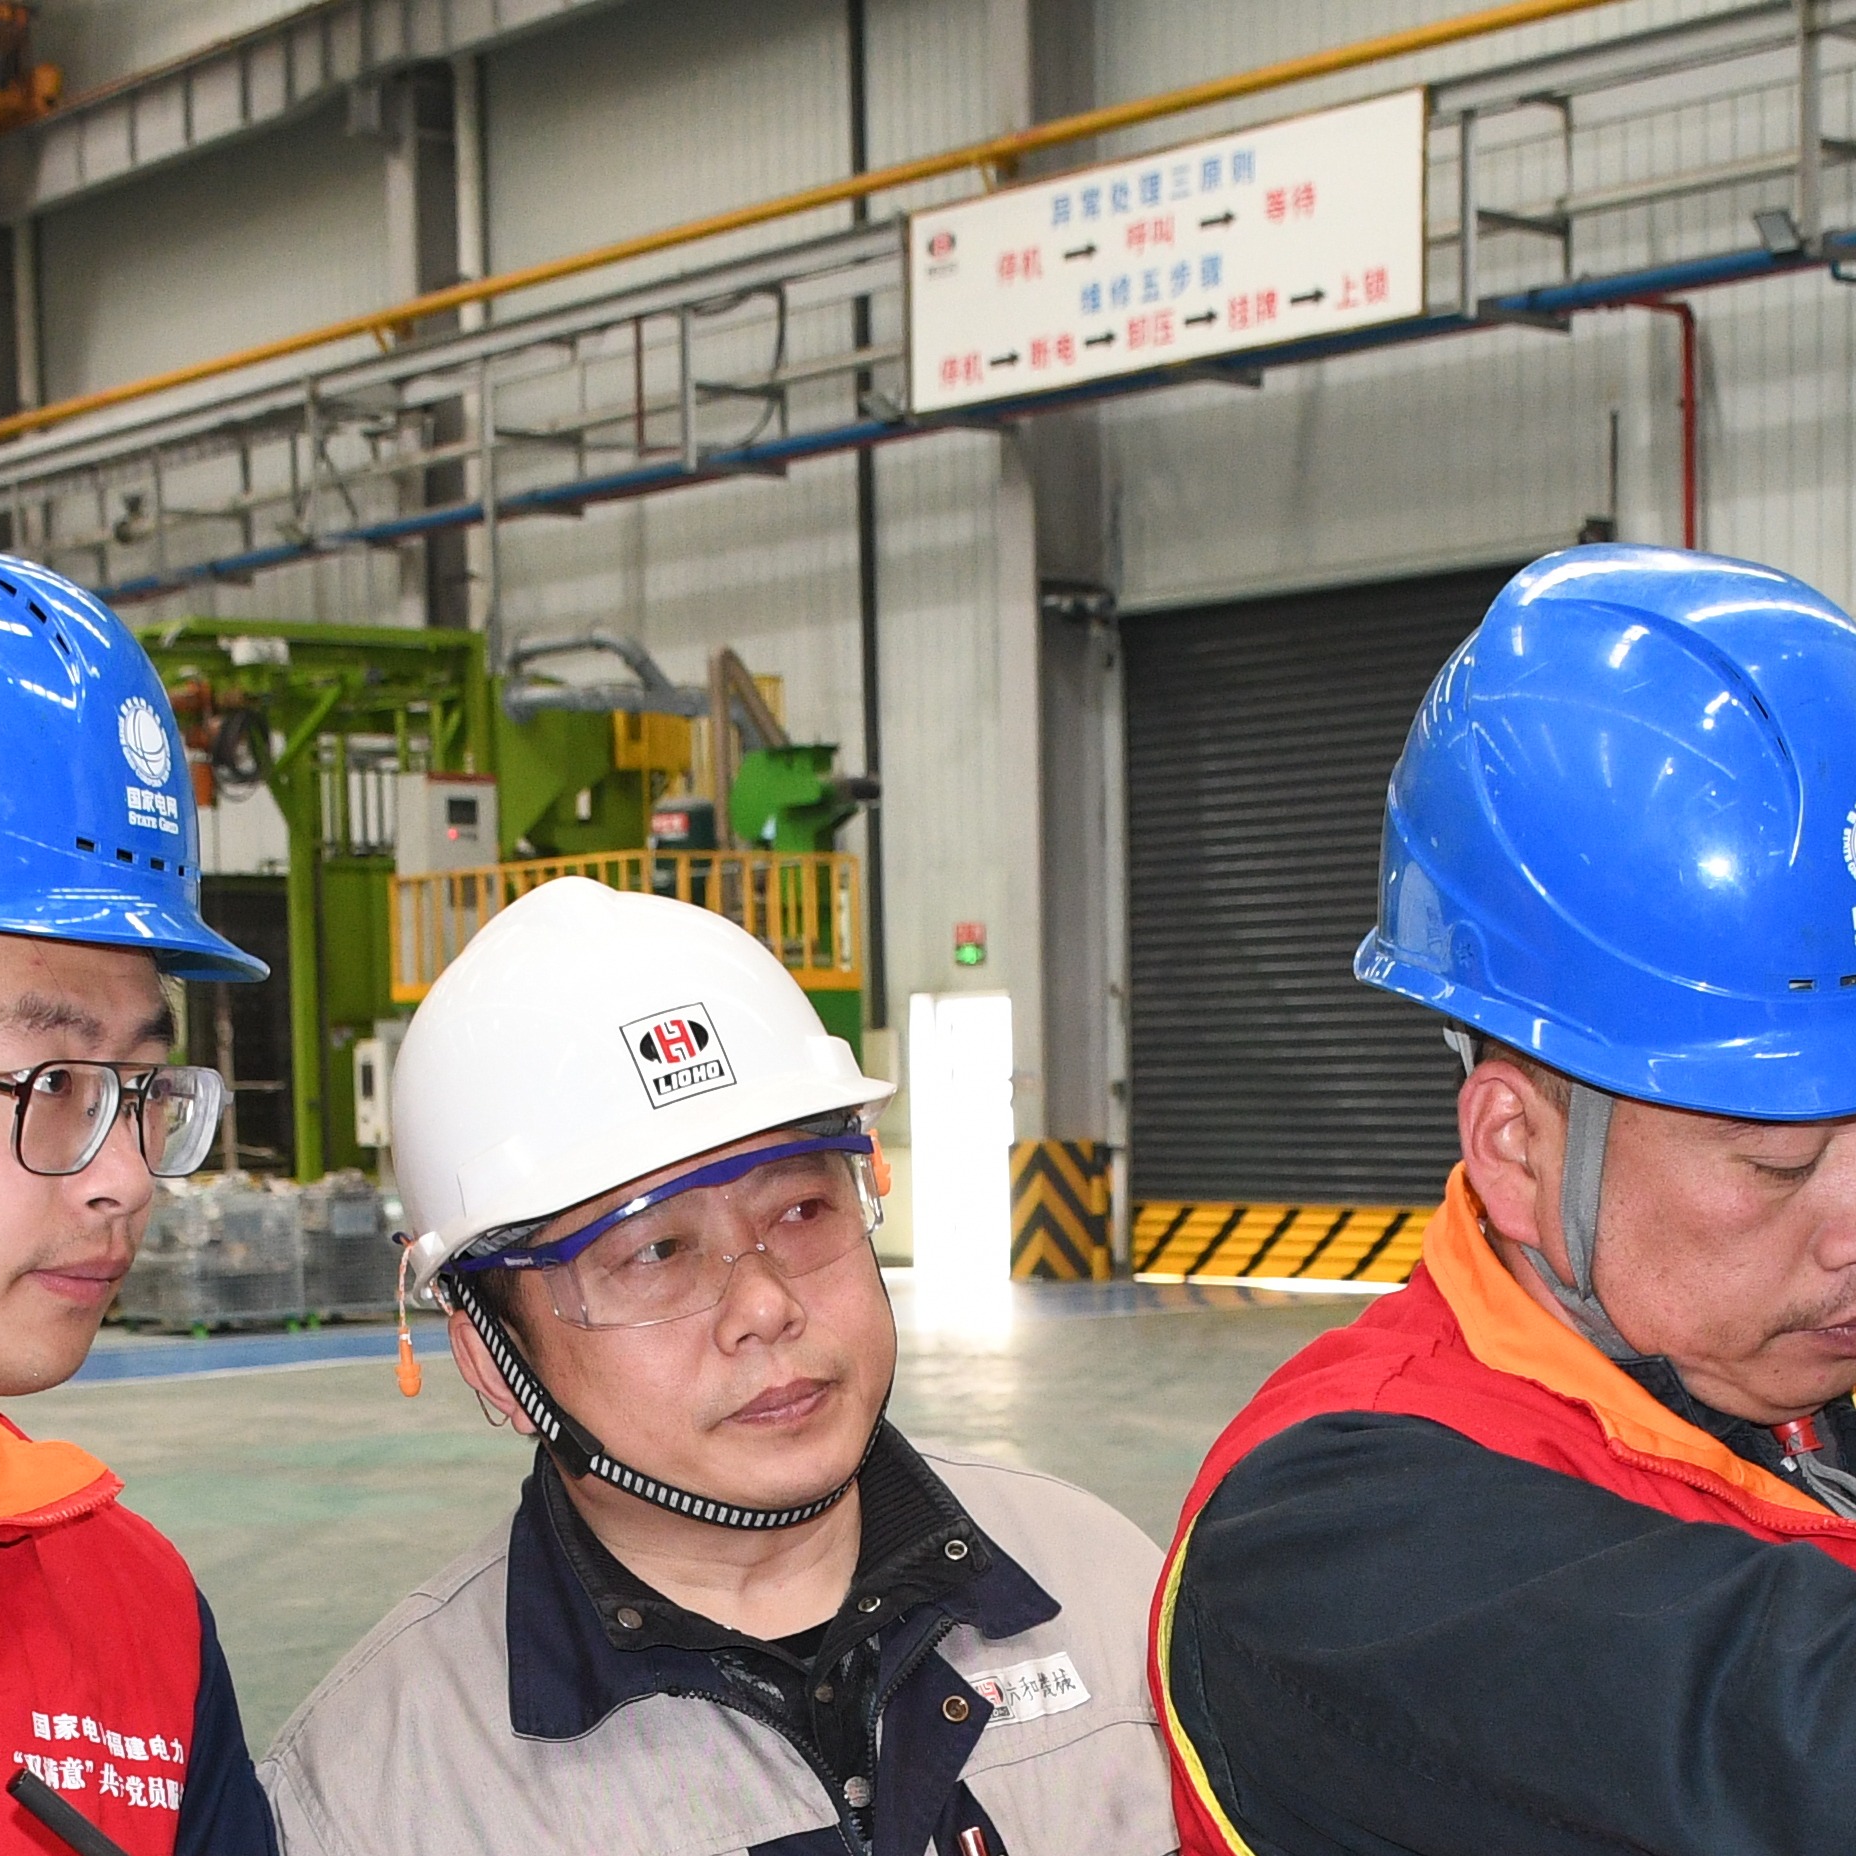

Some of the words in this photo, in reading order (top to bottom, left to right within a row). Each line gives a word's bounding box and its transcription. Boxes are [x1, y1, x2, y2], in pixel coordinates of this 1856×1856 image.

[1052, 150, 1256, 227] 异常处理三原则
[997, 246, 1042, 286] 停机
[1265, 181, 1317, 223] 等待
[1081, 253, 1224, 314] 维修五步骤
[939, 352, 983, 389] 停机
[1030, 333, 1076, 371] 断电
[1228, 290, 1279, 331] 挂牌
[1337, 267, 1390, 310] 上锁
[126, 785, 178, 819] 国家电网
[658, 1060, 722, 1094] LIOHO
[1005, 1667, 1077, 1707] 六和機械
[32, 1711, 185, 1765] 国家电福建电力
